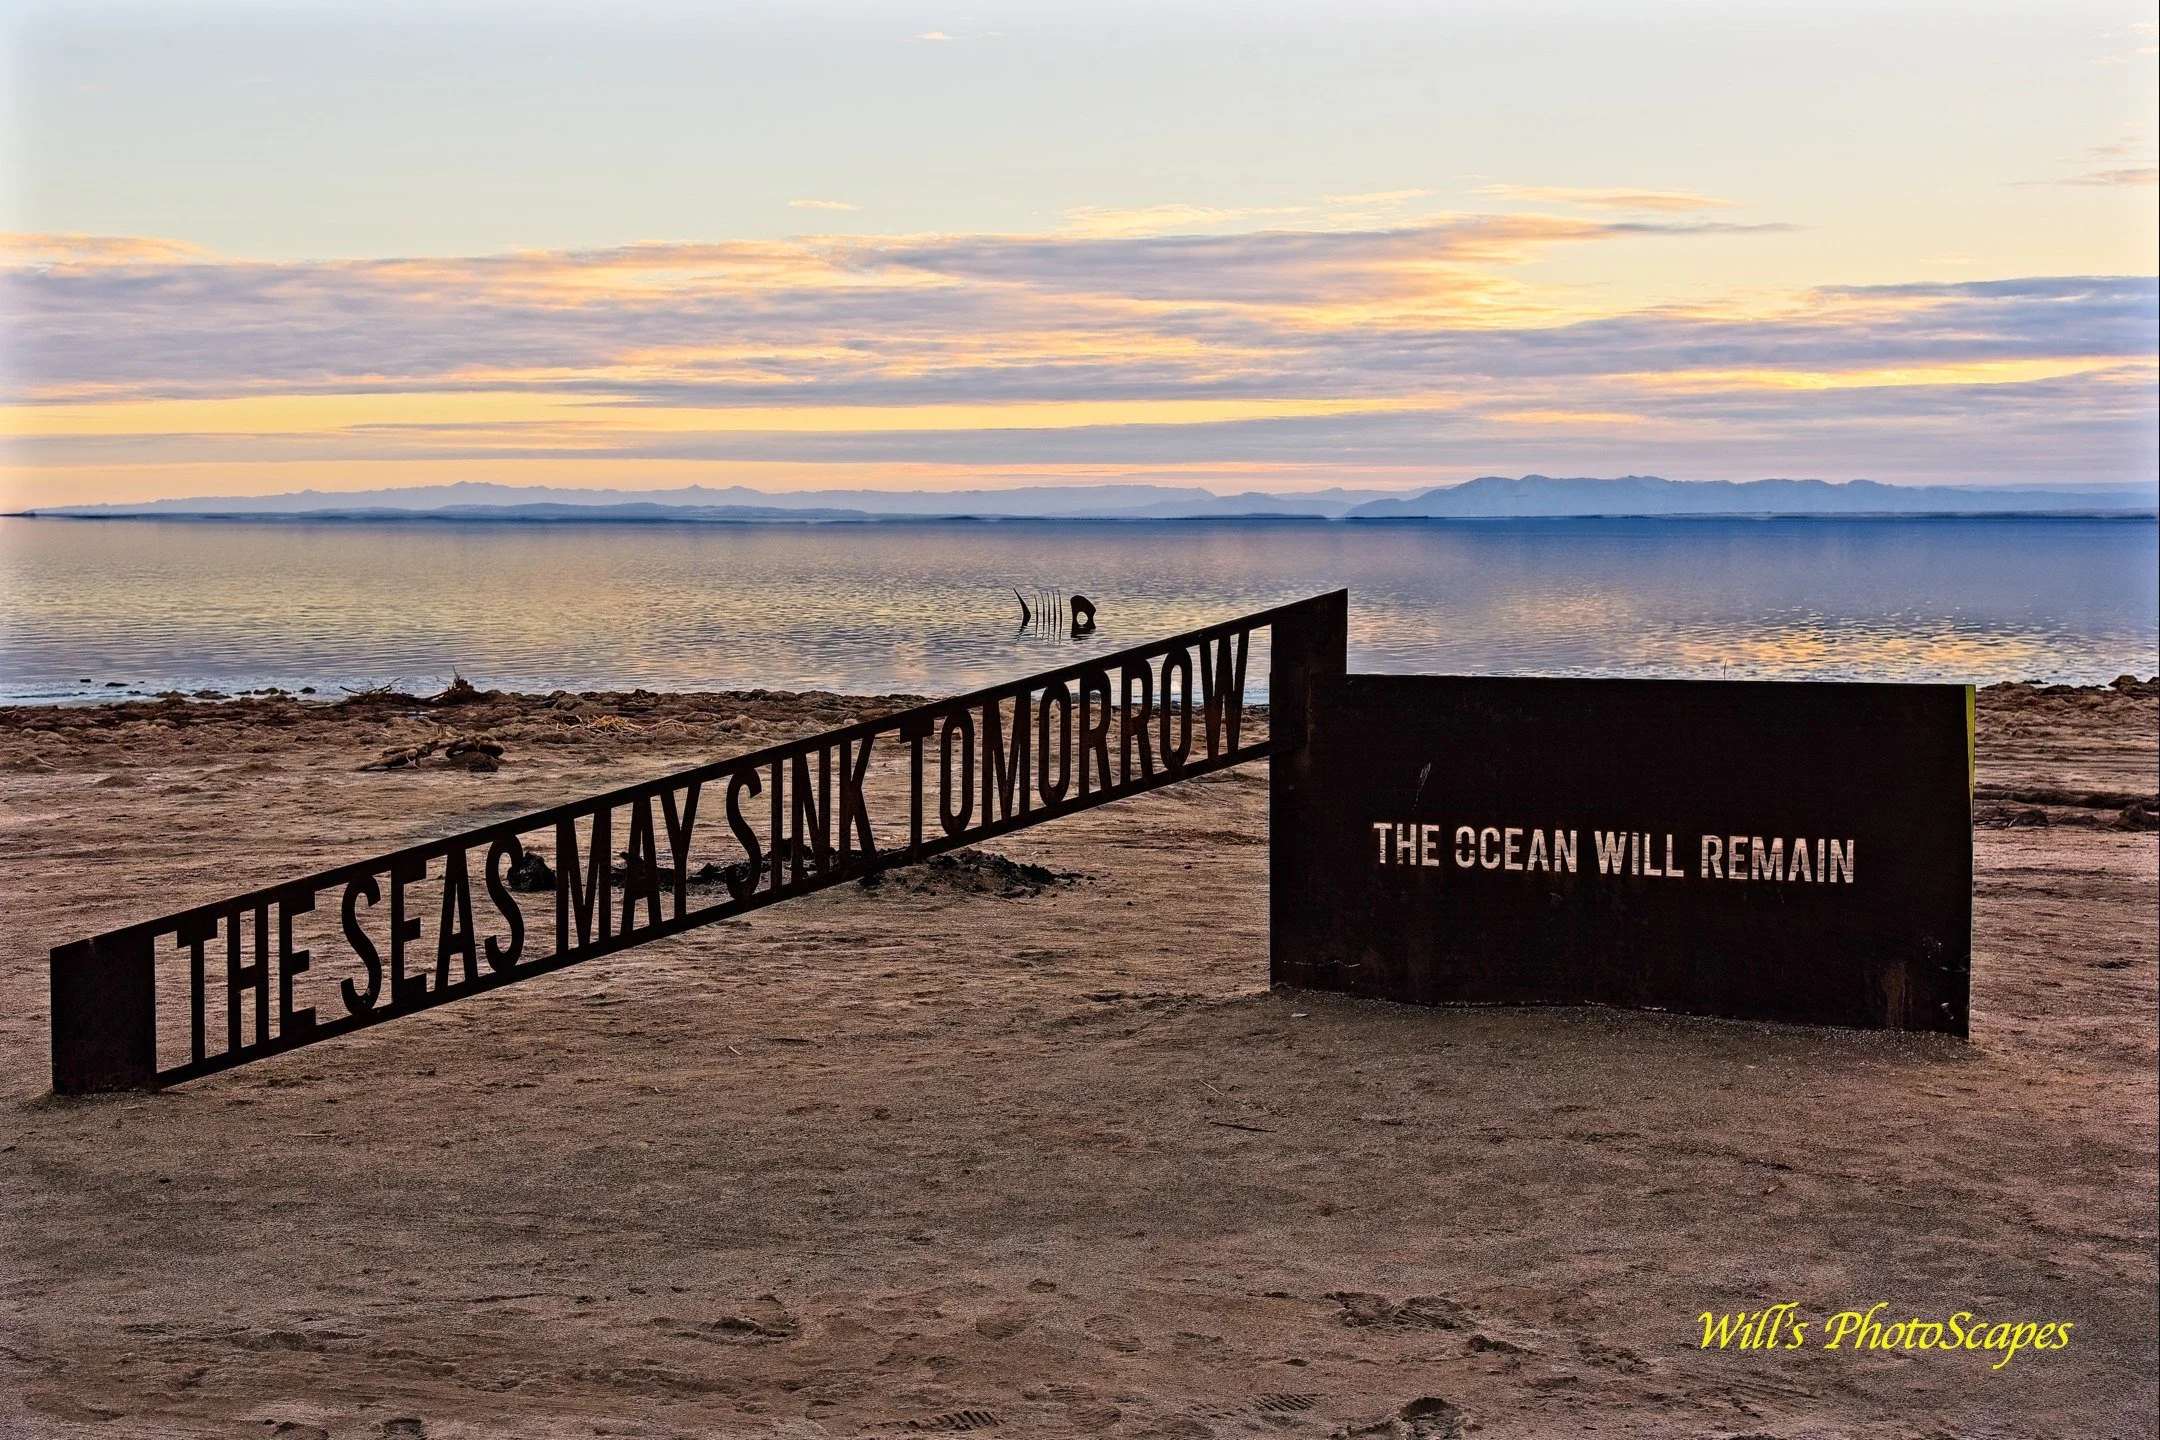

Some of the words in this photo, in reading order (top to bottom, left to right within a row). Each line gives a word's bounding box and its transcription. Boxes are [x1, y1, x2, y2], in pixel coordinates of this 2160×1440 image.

[177, 890, 316, 1067] THE
[340, 833, 526, 1016] SEAS
[556, 784, 702, 958] MAY
[726, 734, 878, 900] SINK
[901, 629, 1250, 846] TOMORROW
[1373, 822, 1440, 867] THE
[1455, 825, 1578, 873] OCEAN
[1594, 830, 1685, 878] WILL
[1701, 834, 1854, 884] REMAIN
